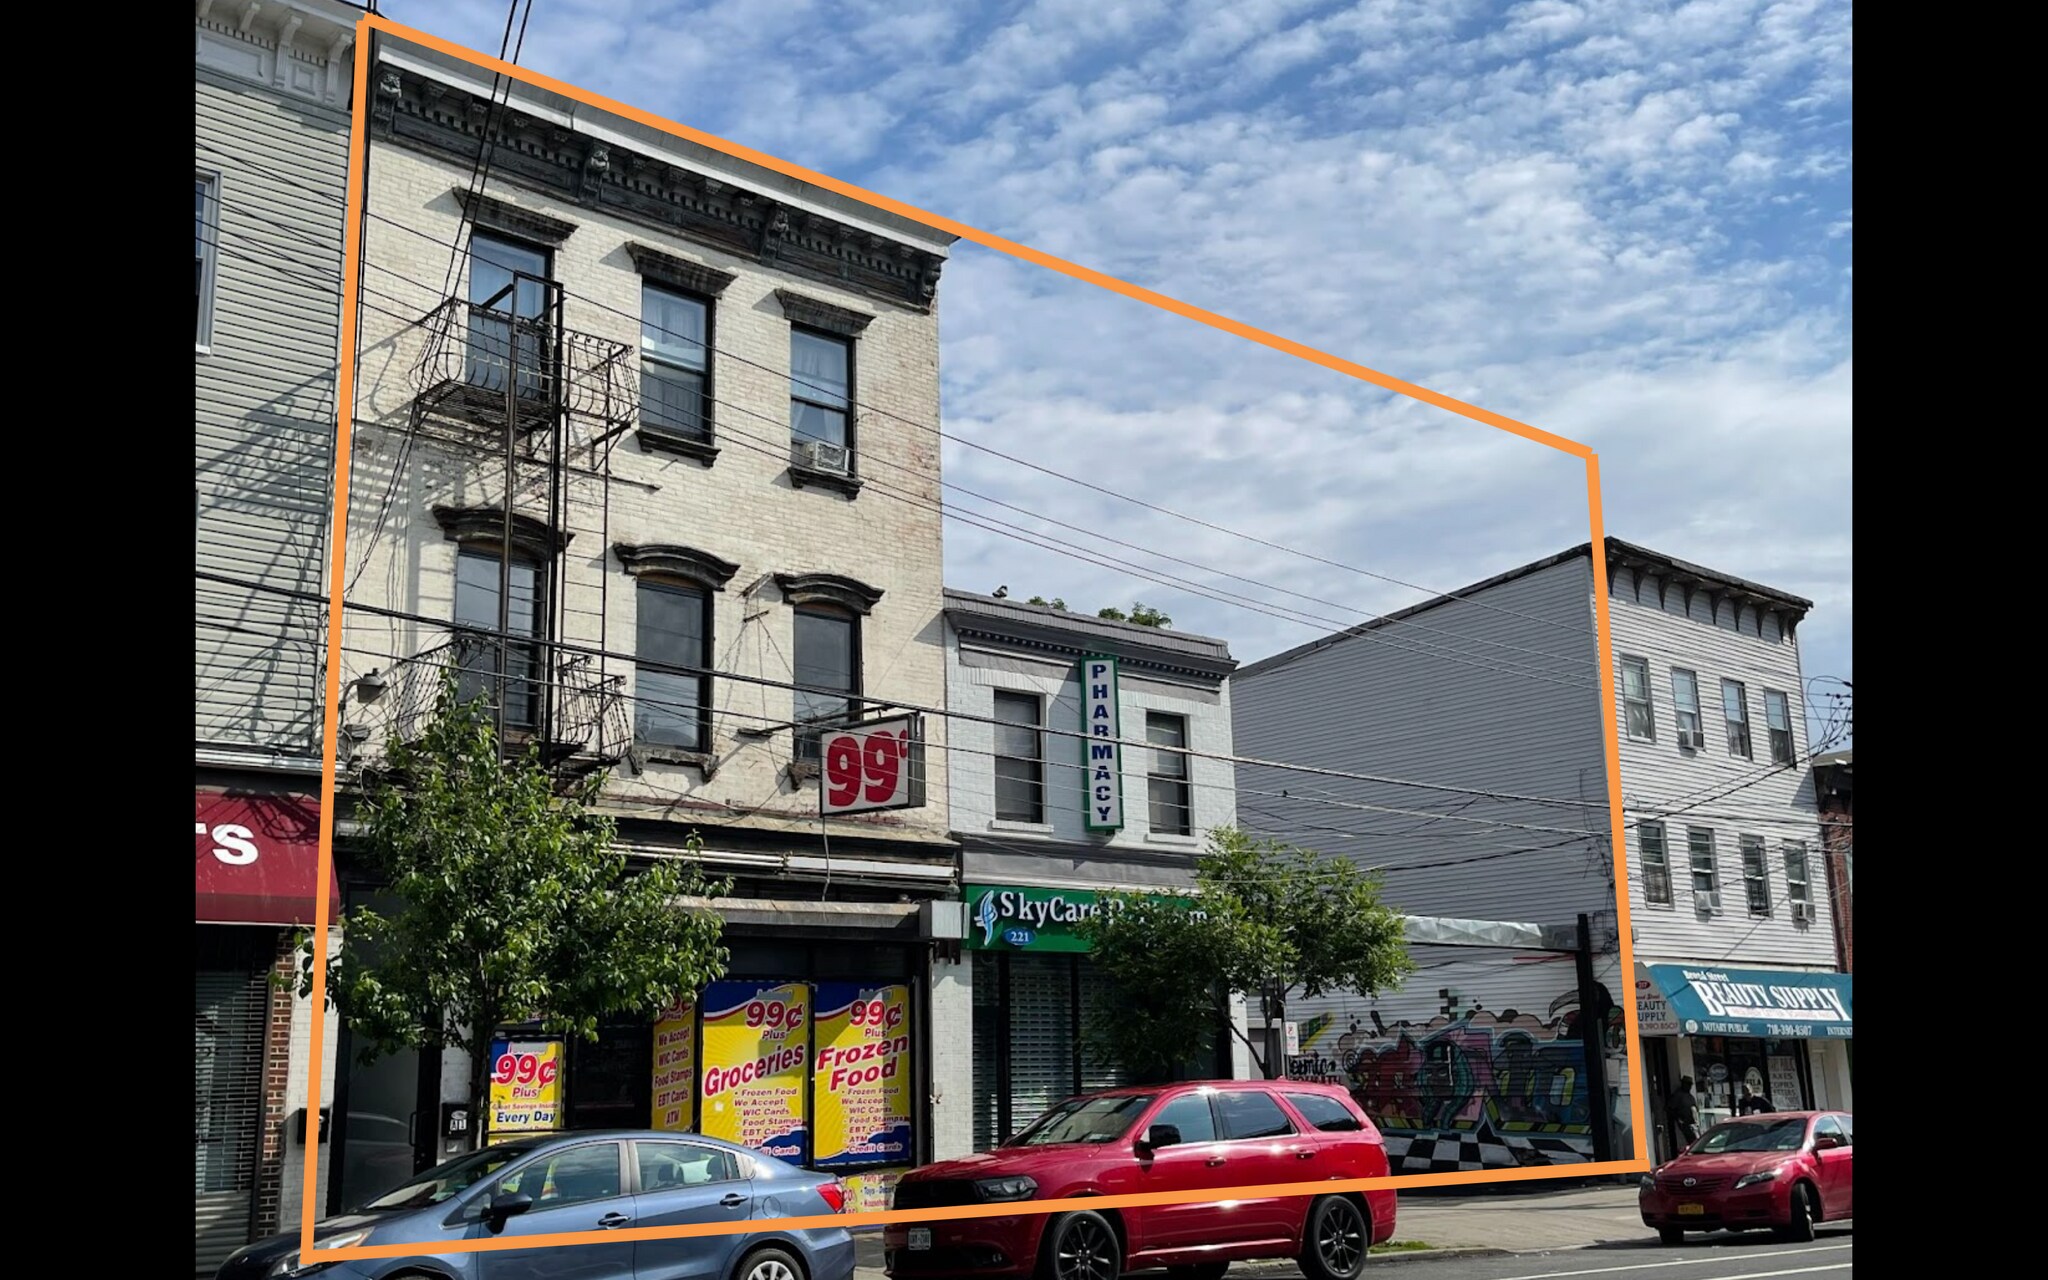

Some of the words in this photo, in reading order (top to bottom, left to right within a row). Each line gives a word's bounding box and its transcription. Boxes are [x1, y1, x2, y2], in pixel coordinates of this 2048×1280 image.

[1091, 664, 1114, 822] PHARMACY
[1000, 890, 1102, 929] SkyCare
[1010, 931, 1029, 943] 221
[1637, 1000, 1667, 1011] EAUTY
[1688, 981, 1774, 1016] BEAUTY
[1769, 985, 1852, 1021] SUPPLY
[746, 1001, 803, 1032] 99¢
[850, 1001, 904, 1030] 99¢
[1638, 1012, 1667, 1022] UPPLY
[669, 1026, 690, 1043] Accept
[762, 1030, 786, 1040] Plus
[864, 1028, 887, 1038] Plus
[658, 1051, 670, 1067] WIC
[671, 1047, 689, 1063] Cards
[817, 1036, 908, 1070] Frozen
[495, 1054, 558, 1089] 99¢
[704, 1044, 804, 1097] Groceries
[830, 1056, 897, 1091] Food
[655, 1074, 669, 1088] Food
[670, 1066, 692, 1083] Stamps
[512, 1087, 537, 1098] Plus
[741, 1088, 772, 1097] Frozen
[774, 1087, 798, 1096] Food
[847, 1087, 877, 1096] Frozen
[879, 1086, 899, 1095] Food
[658, 1091, 670, 1107] EBT
[671, 1088, 689, 1104] Cards
[734, 1099, 748, 1107] We
[743, 1108, 761, 1117] WIC
[764, 1107, 790, 1116] Cards
[868, 1106, 892, 1114] Cards
[496, 1111, 531, 1124] Every
[533, 1110, 557, 1123] Day
[742, 1118, 766, 1127] Food
[768, 1117, 802, 1126] Stamps
[872, 1115, 905, 1124] Stamps
[742, 1128, 761, 1136] EBT
[764, 1127, 791, 1136] Cards
[848, 1126, 867, 1134] EBT
[742, 1138, 763, 1146] ATM
[773, 1146, 799, 1155] Cards
[848, 1144, 876, 1153] Credit
